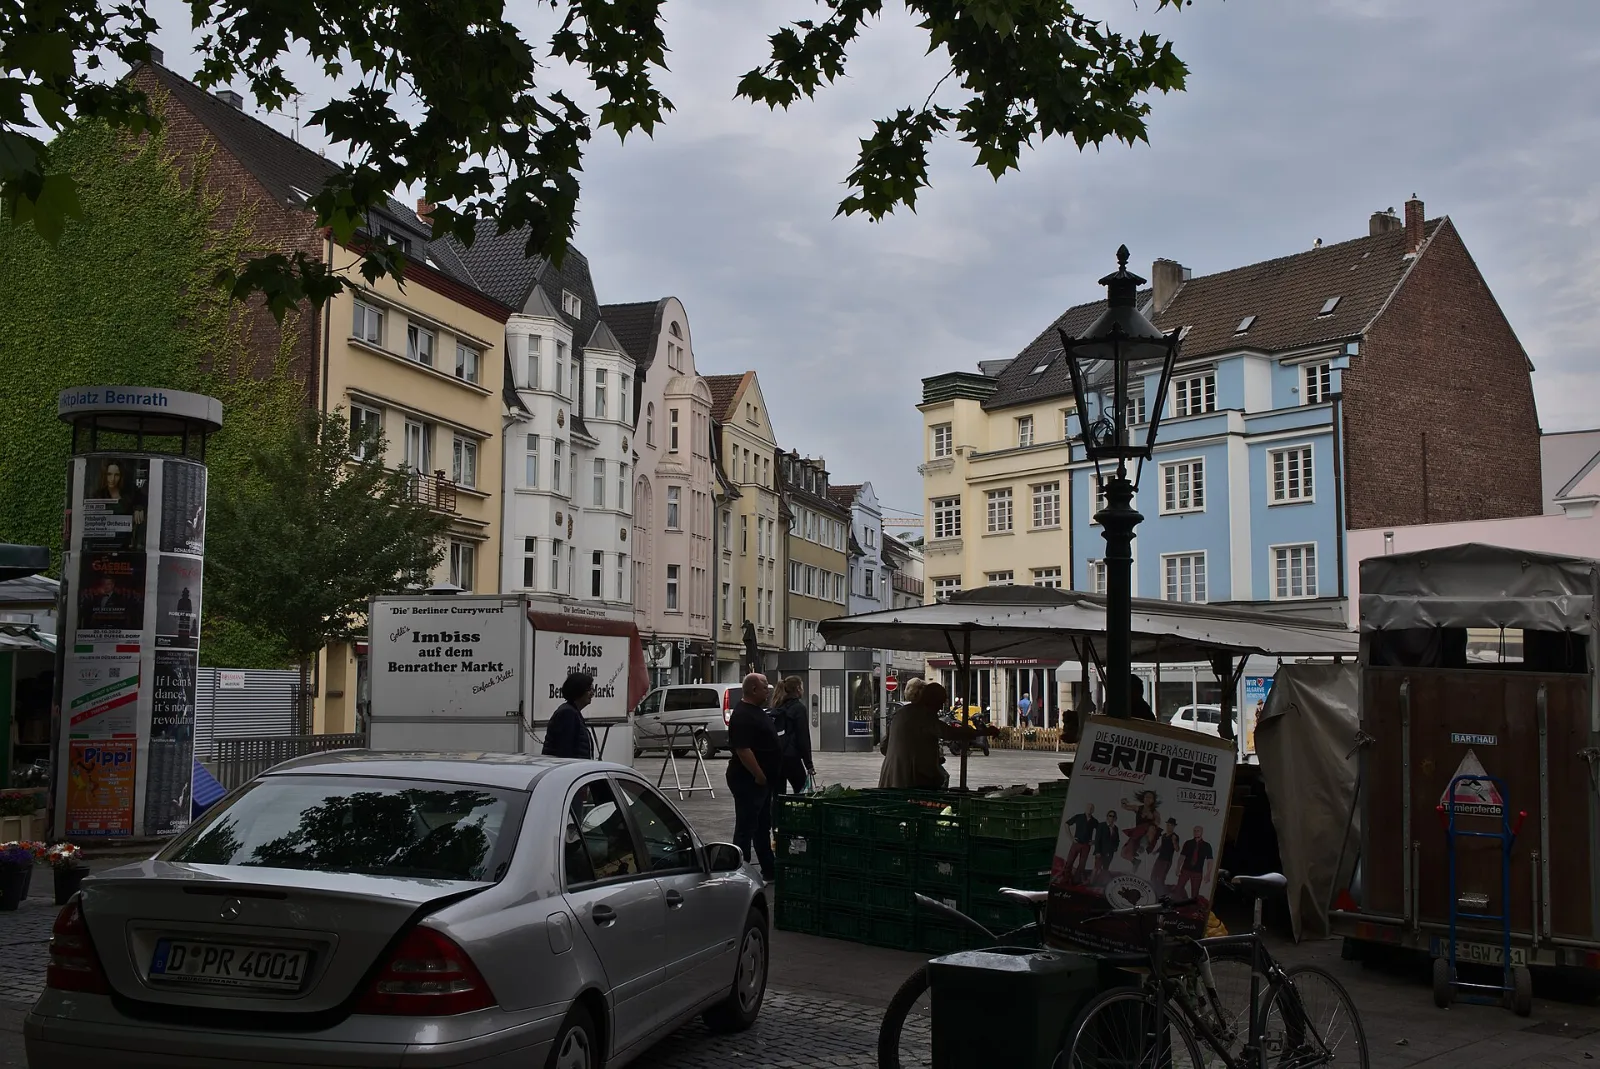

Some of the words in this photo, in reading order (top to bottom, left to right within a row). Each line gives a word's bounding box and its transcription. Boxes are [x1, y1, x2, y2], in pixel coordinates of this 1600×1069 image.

[105, 391, 167, 407] Benrath
[412, 606, 449, 615] Berliner
[451, 606, 504, 618] Currywurst
[571, 607, 586, 615] Berliner
[412, 631, 481, 643] Imbiss
[418, 646, 442, 658] auf
[445, 647, 473, 658] dem
[563, 639, 603, 658] Imbiss
[388, 661, 458, 673] Benrather
[461, 661, 504, 673] Markt
[582, 662, 599, 677] dem
[156, 676, 165, 686] If
[167, 676, 171, 686] I
[1246, 679, 1257, 687] WIR
[154, 701, 170, 712] it's
[1454, 735, 1495, 744] BARTHAU
[1095, 730, 1108, 742] DIE
[1109, 733, 1160, 753] SAUBANDE
[1161, 745, 1219, 766] PRÄSENTIERT
[85, 747, 132, 766] Pippi
[1090, 741, 1217, 788] BRINGS
[1107, 766, 1149, 781] Concert
[1444, 802, 1502, 815] Trnierpferde
[1117, 877, 1149, 890] SAUBANDE
[1471, 945, 1491, 961] GW
[1494, 948, 1524, 966] 71
[168, 945, 187, 971] D
[201, 947, 235, 976] PR
[238, 951, 300, 981] 4001
